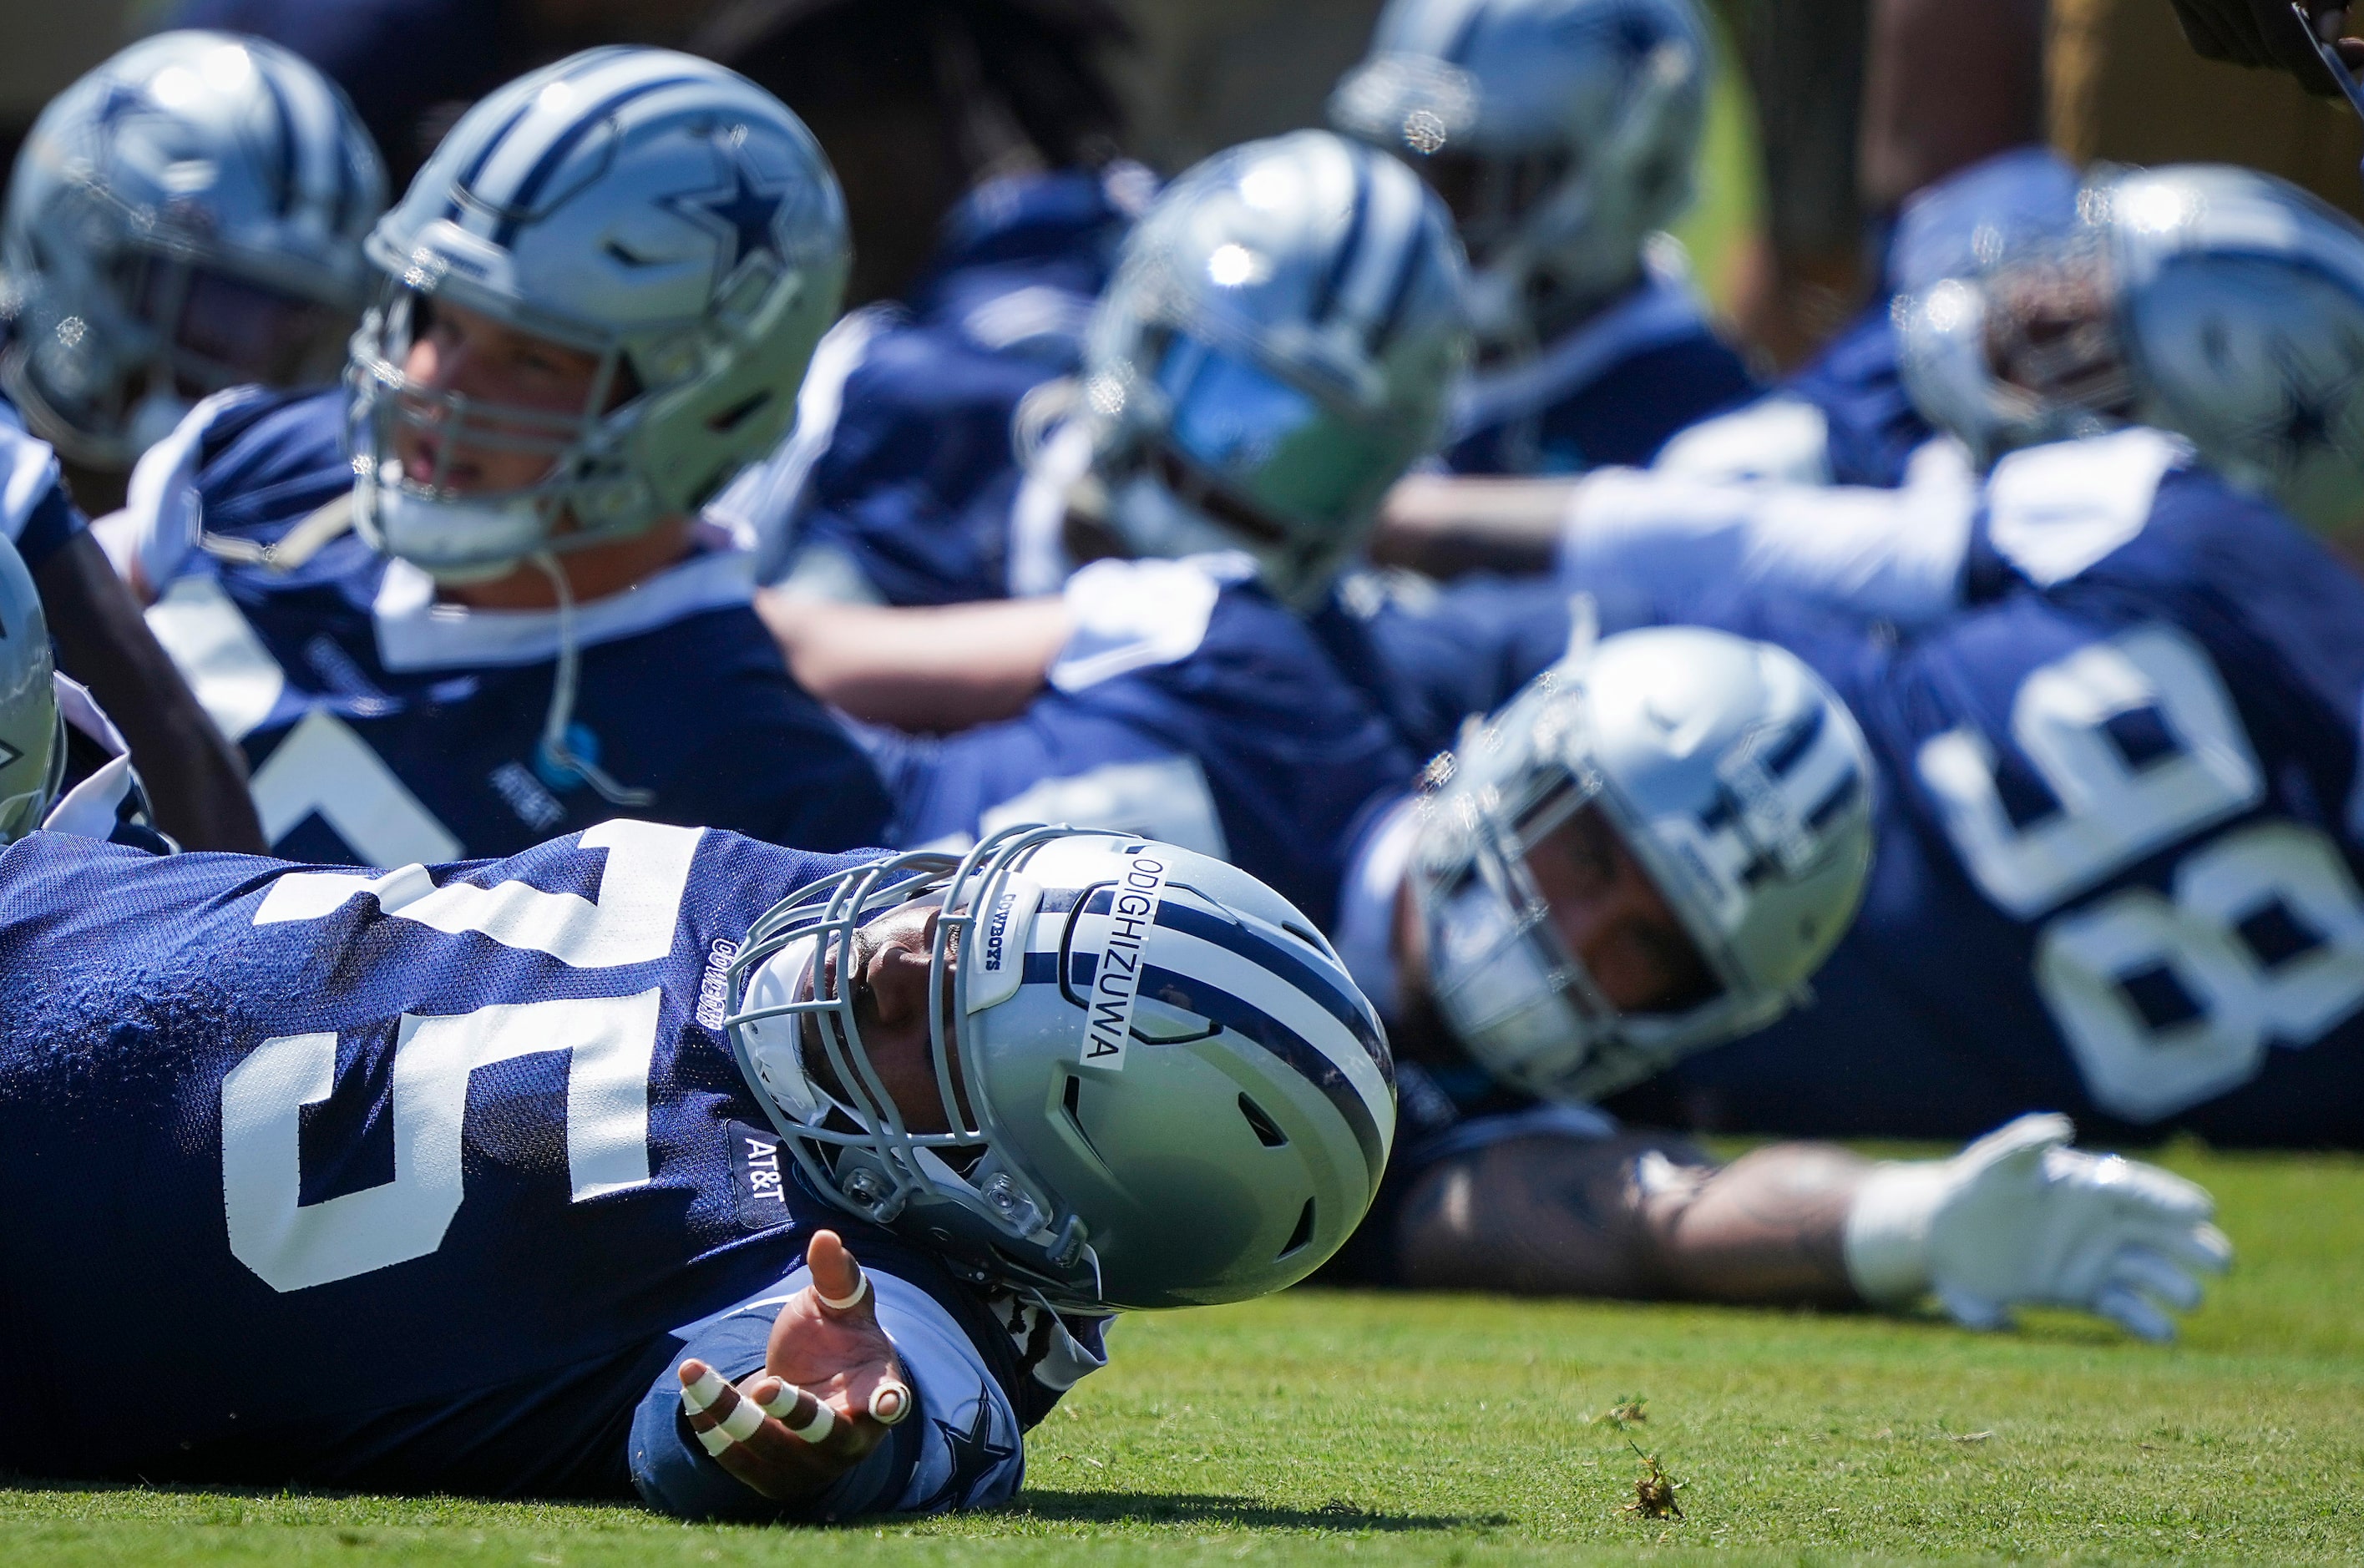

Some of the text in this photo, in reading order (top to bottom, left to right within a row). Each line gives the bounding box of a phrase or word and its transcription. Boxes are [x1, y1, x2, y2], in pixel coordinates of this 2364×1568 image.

[985, 893, 1017, 971] COWBOYS
[1086, 858, 1164, 1059] ODIGHIZUWA
[1917, 623, 2364, 1124] 98
[222, 818, 706, 1293] 75
[745, 1138, 785, 1202] AT&T
